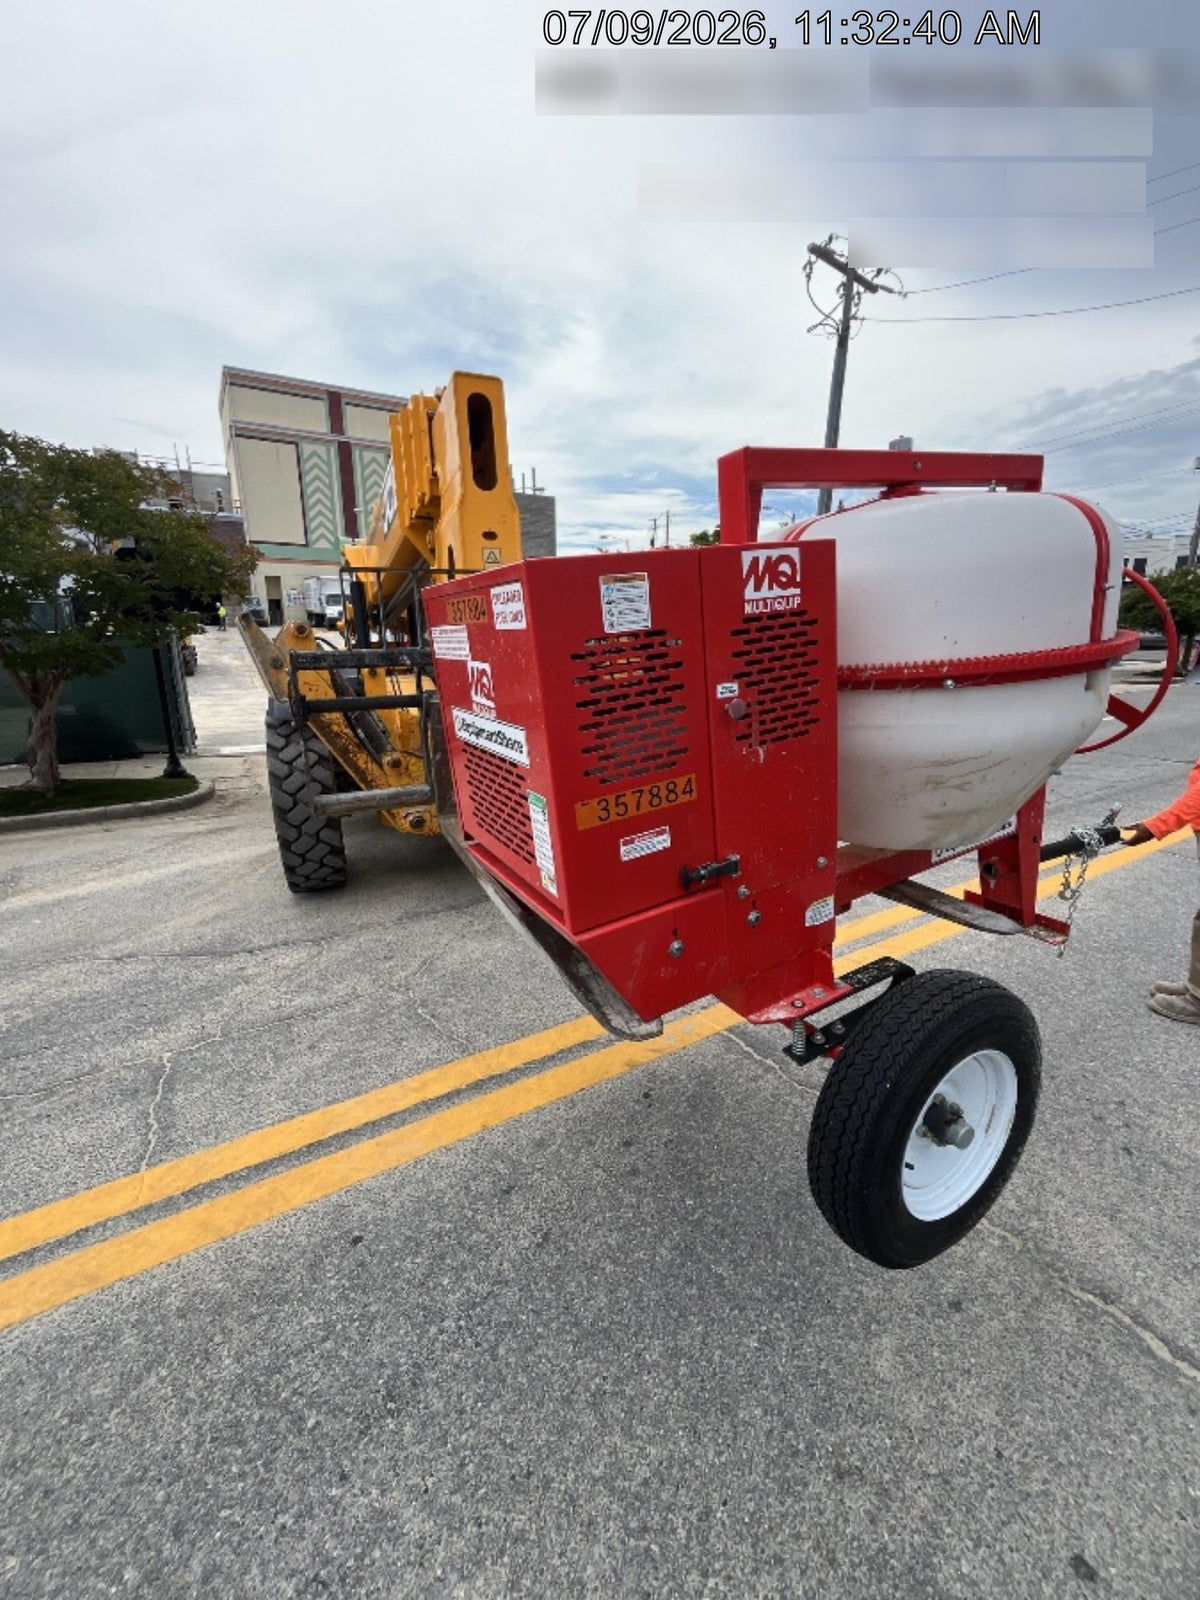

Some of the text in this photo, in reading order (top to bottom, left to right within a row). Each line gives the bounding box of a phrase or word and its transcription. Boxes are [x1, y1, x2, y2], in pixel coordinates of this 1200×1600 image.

[743, 554, 801, 593] MQ
[744, 597, 801, 614] MULTIQUIP
[596, 776, 695, 822] 357884
